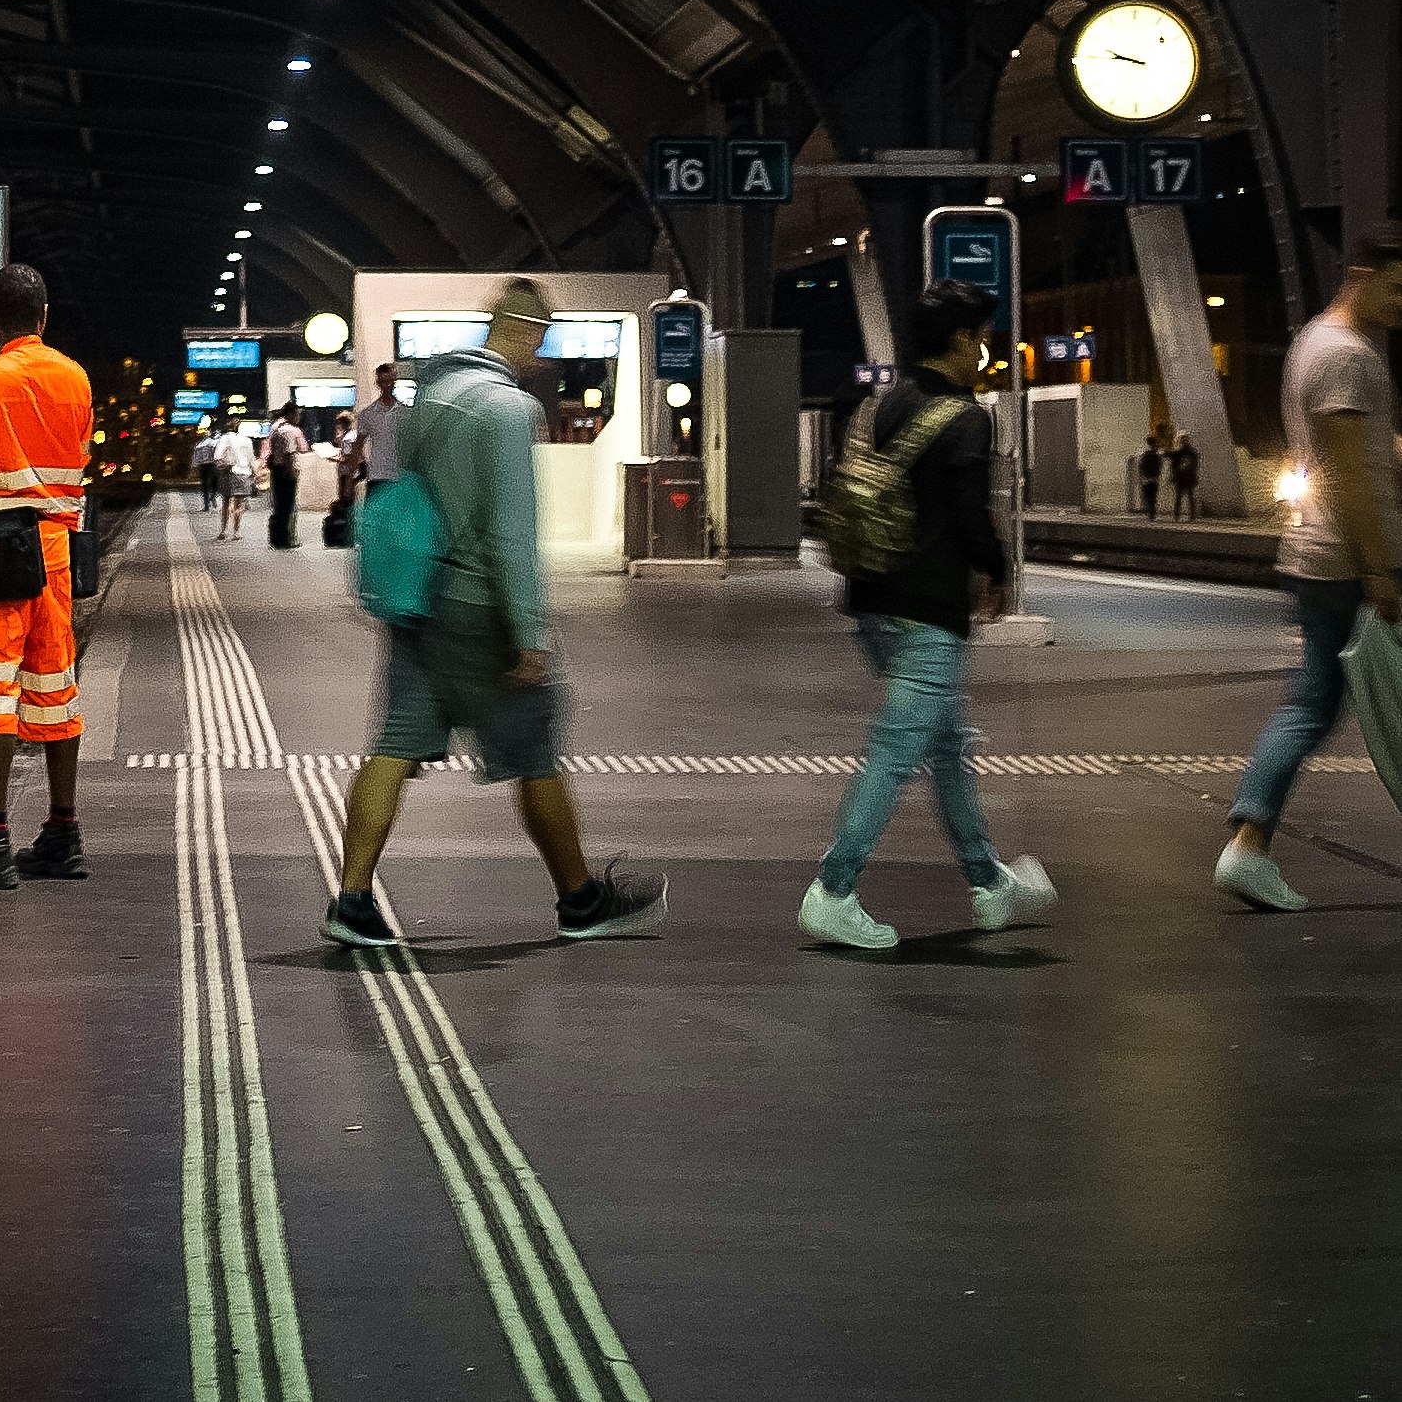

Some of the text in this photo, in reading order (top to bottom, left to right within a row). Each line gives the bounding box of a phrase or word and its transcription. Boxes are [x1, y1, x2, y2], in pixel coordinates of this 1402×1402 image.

[664, 158, 705, 192] 16
[744, 159, 772, 192] A
[1082, 158, 1113, 192] A
[1150, 158, 1191, 192] 17
